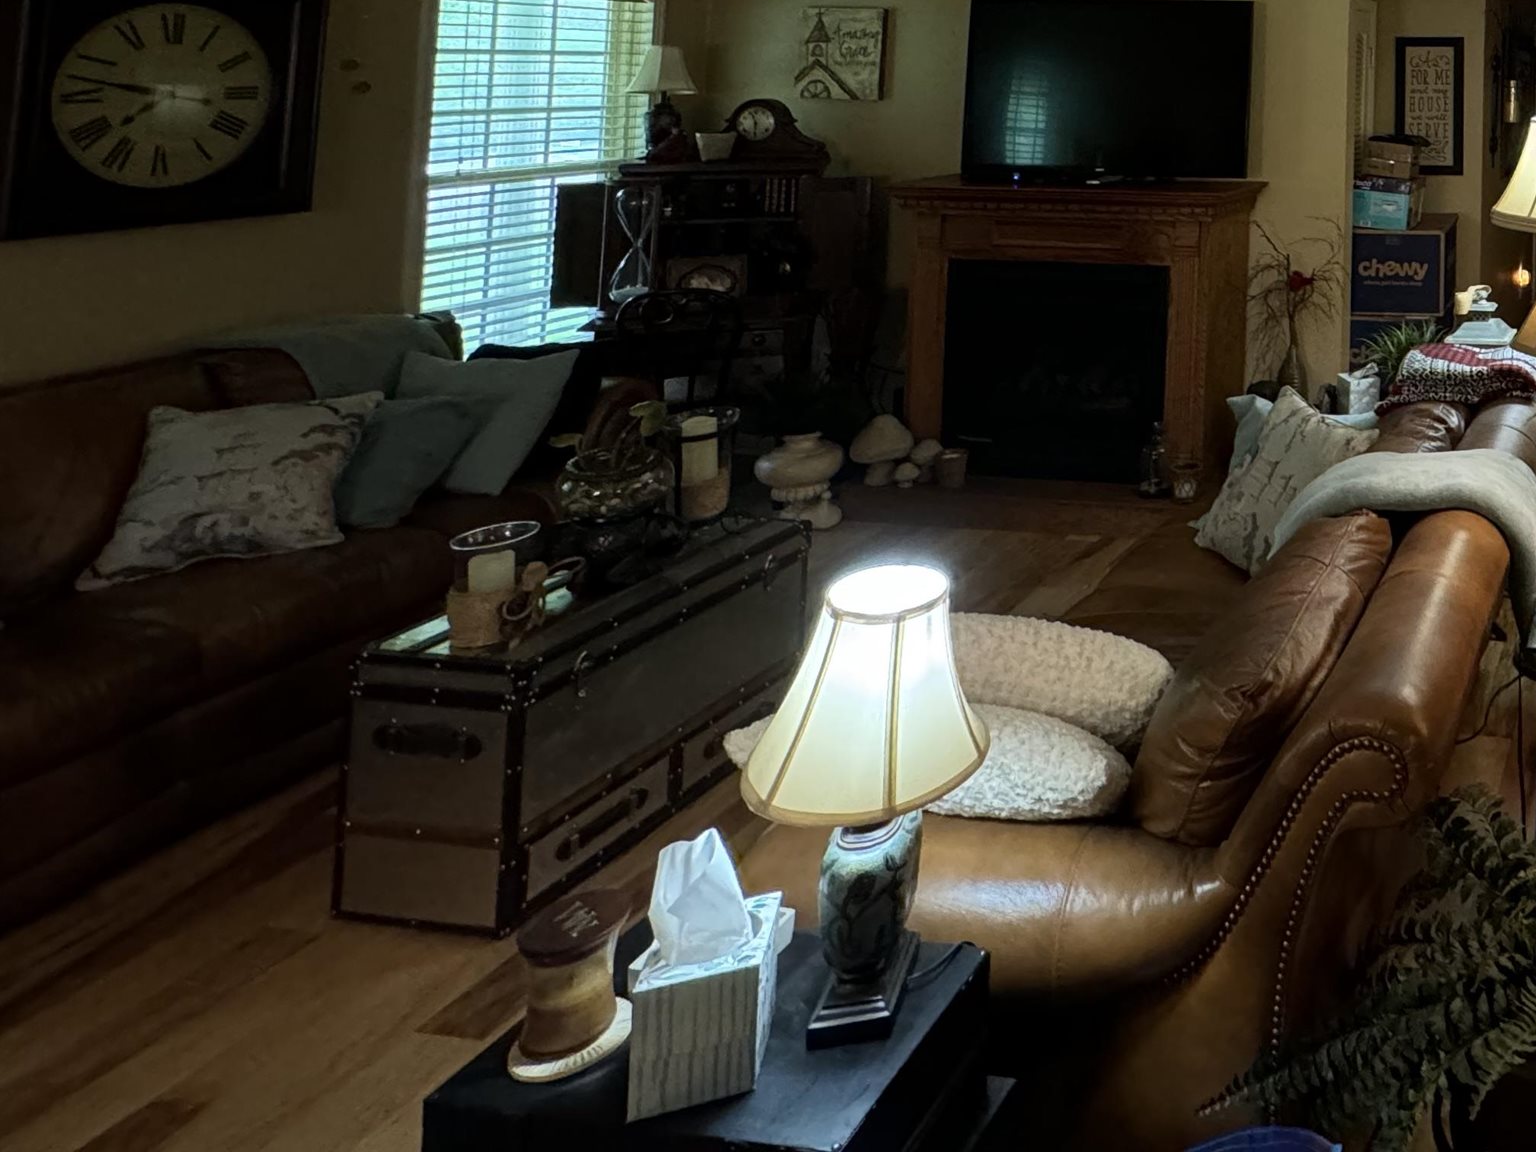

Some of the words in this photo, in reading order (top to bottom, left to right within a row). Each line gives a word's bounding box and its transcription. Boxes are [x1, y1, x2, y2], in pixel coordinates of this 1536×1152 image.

[1410, 69, 1429, 86] FOR
[1434, 69, 1451, 86] ME
[1409, 96, 1450, 113] HOUSE
[1408, 122, 1450, 139] SERVE
[1358, 258, 1429, 281] chewy
